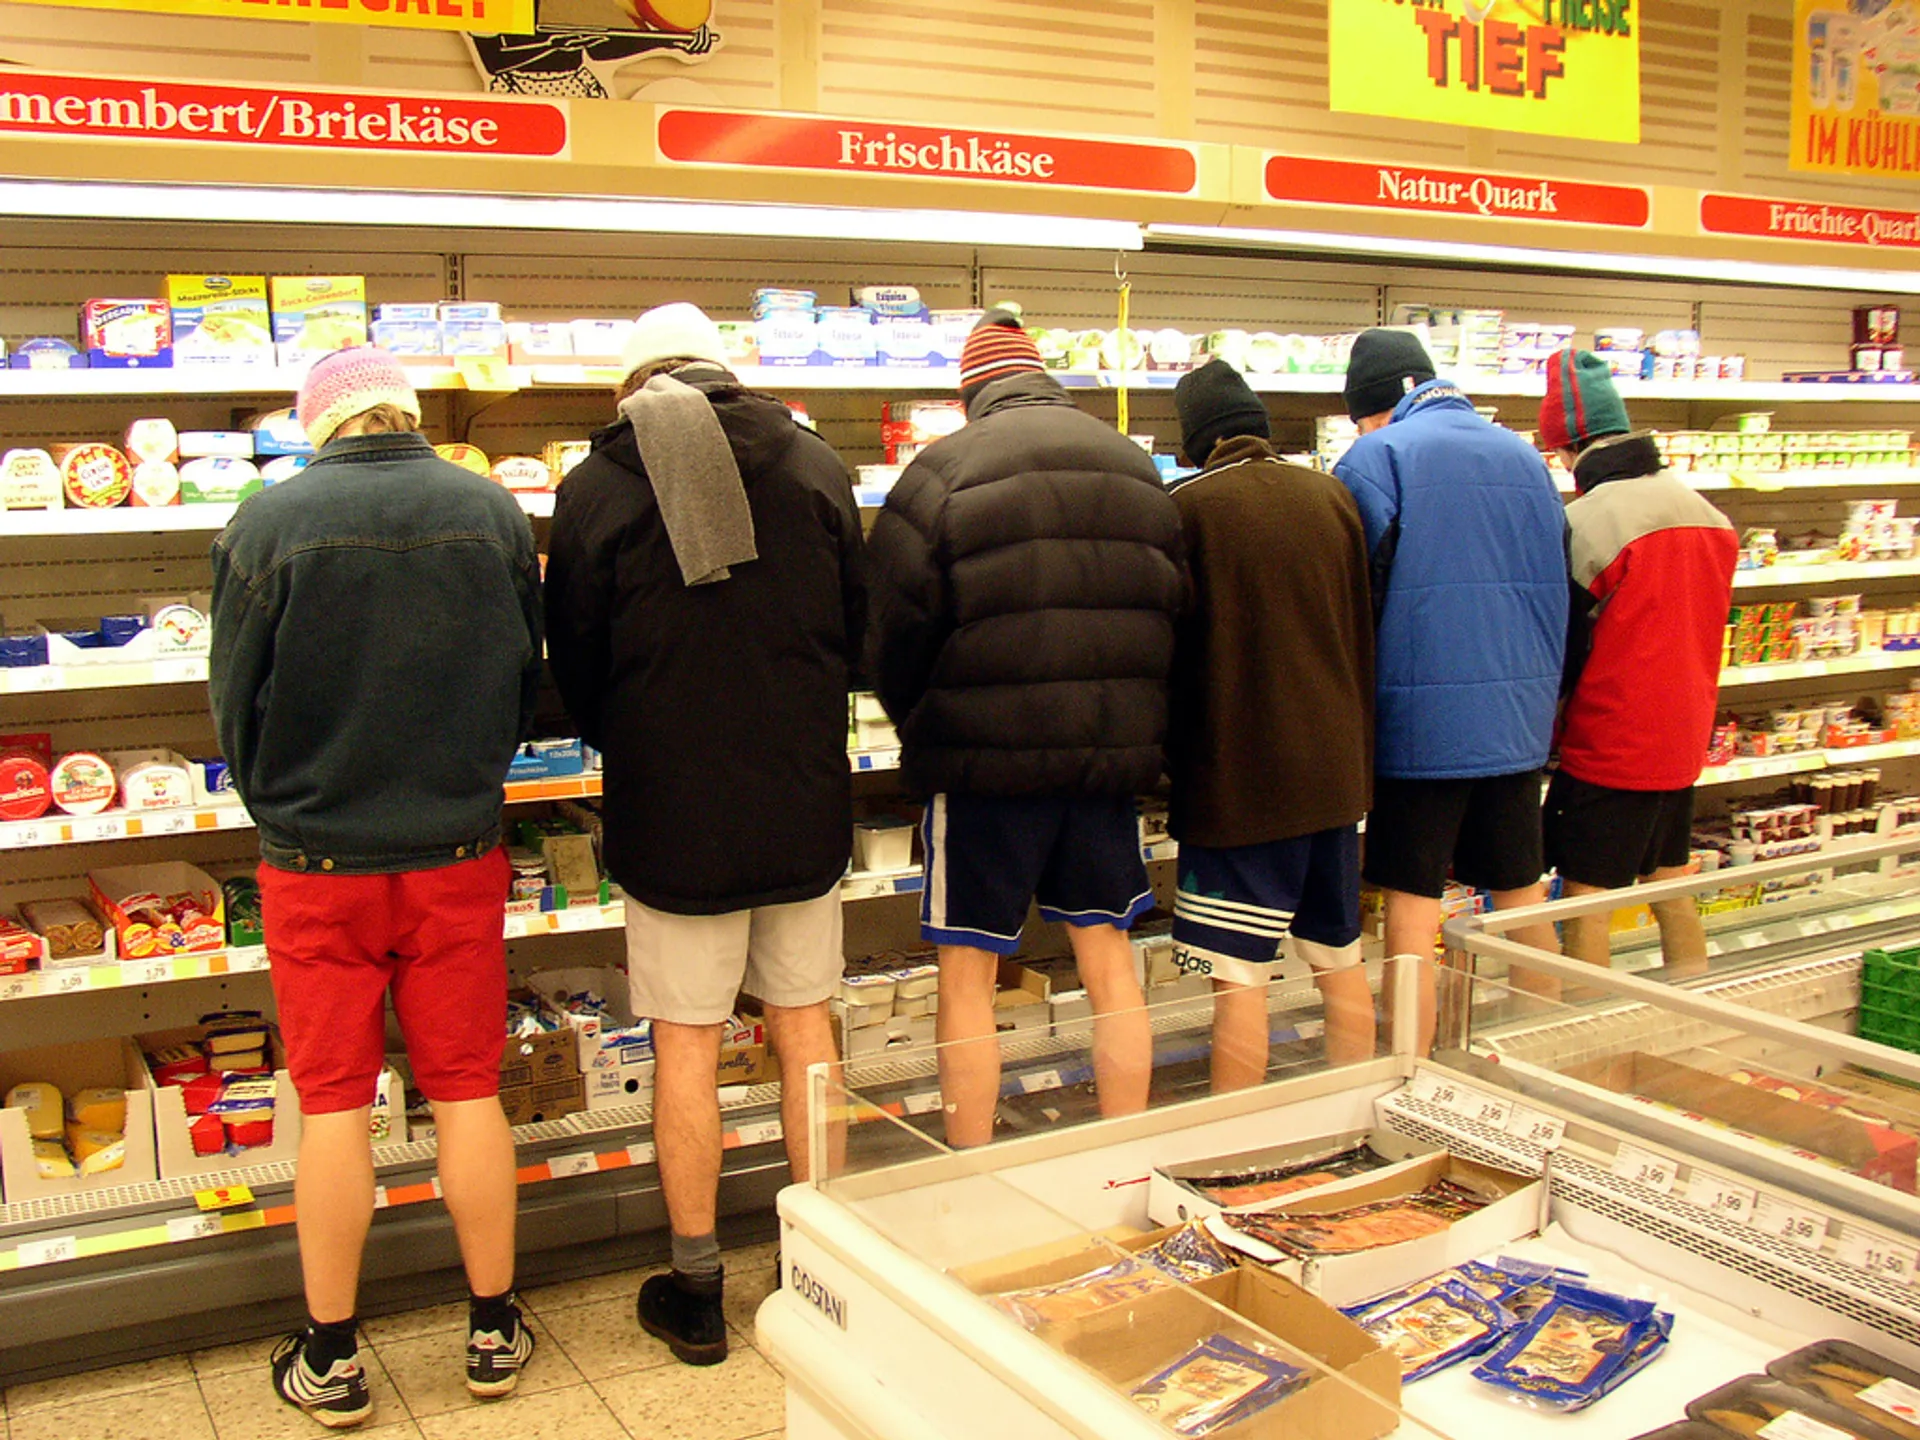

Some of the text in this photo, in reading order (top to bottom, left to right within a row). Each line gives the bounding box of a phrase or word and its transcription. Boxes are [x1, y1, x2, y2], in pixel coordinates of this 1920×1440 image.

[1415, 8, 1565, 100] TIEF
[0, 88, 498, 146] membert/Briekäse
[838, 130, 1055, 178] Frischkäse
[1806, 114, 1839, 165] IM
[1377, 169, 1557, 213] Natur-Quark
[1532, 1123, 1554, 1140] 2.99
[1640, 1164, 1665, 1183] 3.99
[1716, 1191, 1742, 1211] 1.99
[1786, 1217, 1814, 1238] 3.99
[1865, 1249, 1904, 1273] 11.50
